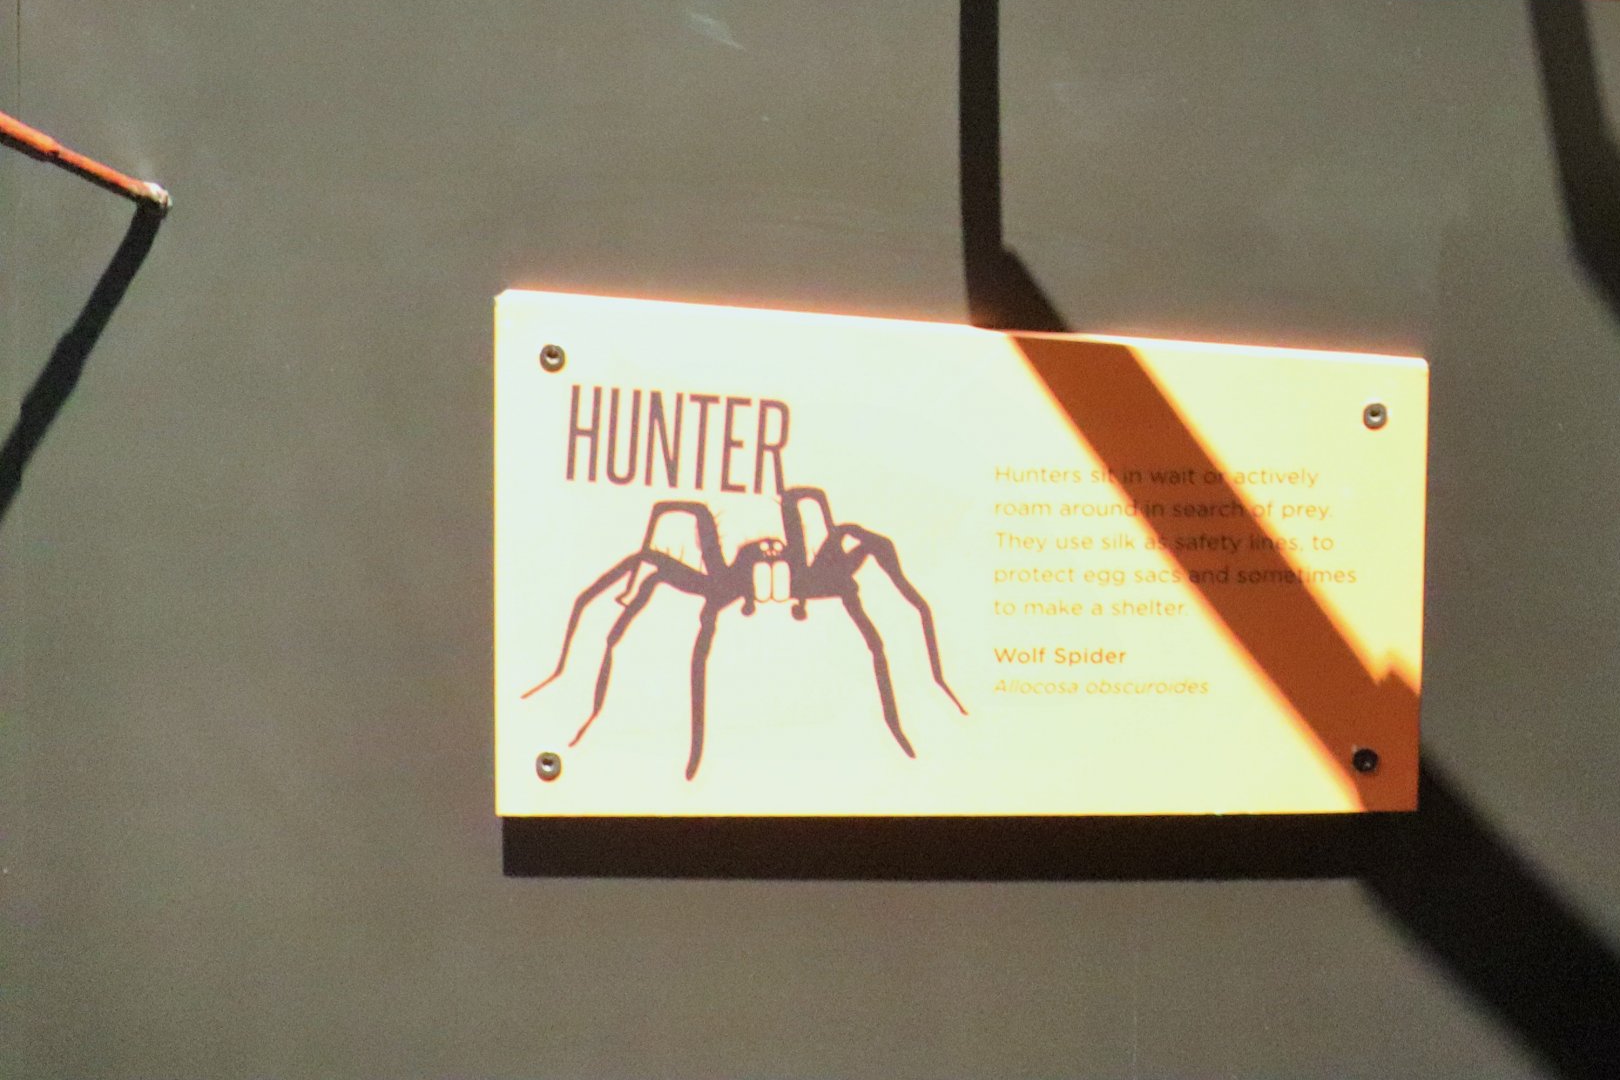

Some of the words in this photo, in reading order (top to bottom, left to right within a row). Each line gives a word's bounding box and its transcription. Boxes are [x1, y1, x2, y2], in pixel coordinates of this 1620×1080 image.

[566, 385, 790, 495] HUNTER
[995, 467, 1082, 484] Hunters
[1090, 468, 1114, 484] sit
[1122, 469, 1143, 484] in
[1150, 469, 1196, 485] wait
[1202, 470, 1225, 485] or
[1234, 468, 1320, 488] actively
[994, 503, 1052, 517] roam
[1059, 500, 1137, 517] around
[1145, 501, 1165, 517] in
[1172, 500, 1248, 518] search
[1253, 500, 1274, 518] of
[1281, 503, 1333, 521] prey.
[995, 532, 1046, 552] They
[1056, 536, 1094, 550] use
[1101, 533, 1136, 551] silk
[1144, 536, 1168, 551] as
[1175, 534, 1239, 554] safety
[1249, 534, 1304, 553] lines,
[1312, 536, 1334, 551] to
[994, 567, 1075, 586] protect
[1083, 569, 1126, 587] egg
[1134, 569, 1181, 584] sacs
[1188, 567, 1230, 584] and
[1236, 567, 1358, 584] sometimes
[993, 601, 1016, 616] to
[1024, 599, 1084, 616] make
[1091, 602, 1103, 616] a
[1111, 600, 1190, 617] shelter.
[993, 647, 1046, 665] Wolf
[1054, 647, 1127, 667] Spider
[993, 679, 1079, 695] Allocosa
[1085, 679, 1209, 696] obscuroides
